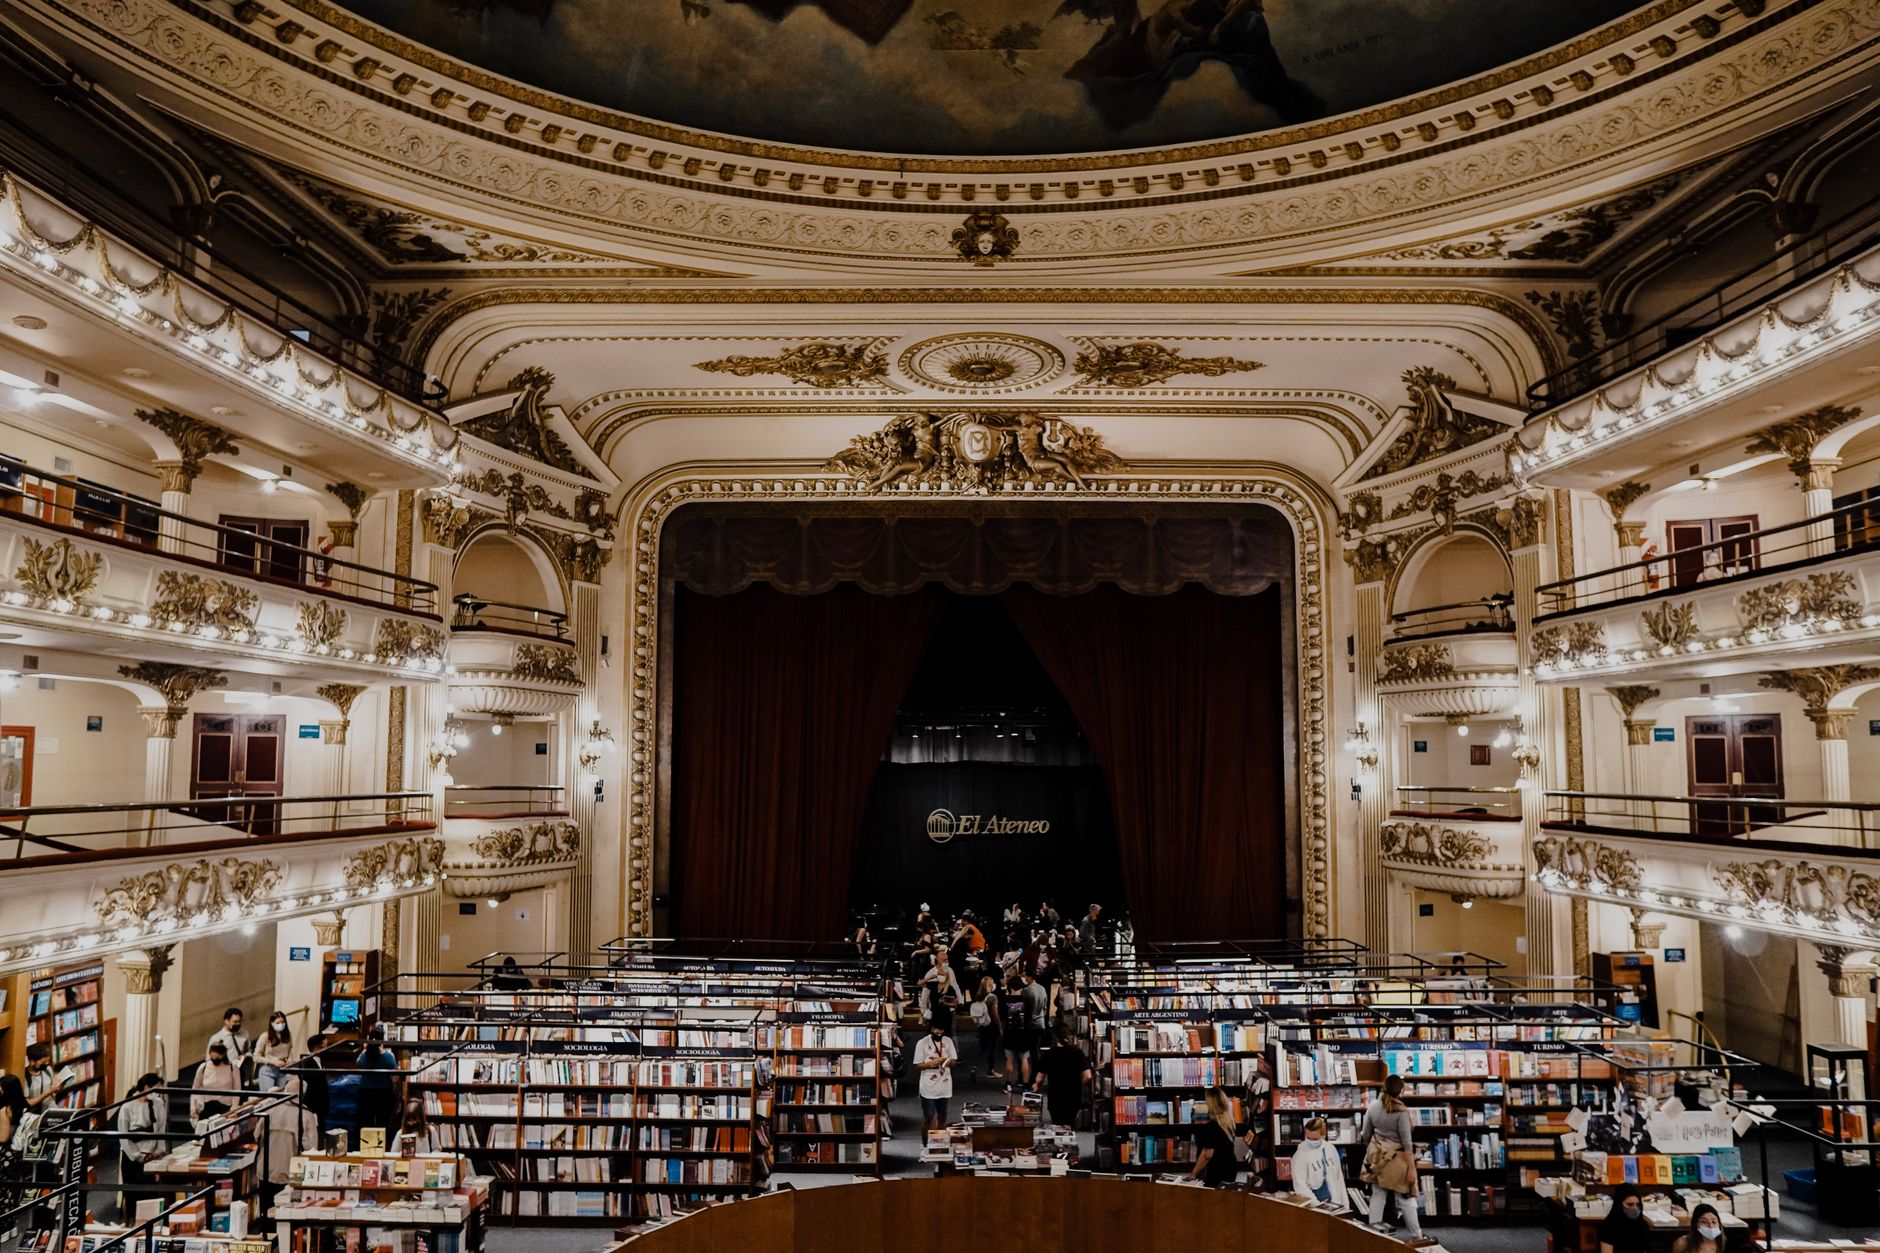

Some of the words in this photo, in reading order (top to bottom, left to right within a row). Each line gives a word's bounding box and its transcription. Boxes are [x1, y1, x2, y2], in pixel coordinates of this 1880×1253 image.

[956, 815, 981, 835] El
[981, 815, 1050, 835] Ateneo
[1682, 1124, 1703, 1140] Harry
[1703, 1123, 1729, 1138] Potter
[68, 1146, 83, 1227] BIBLITECA
